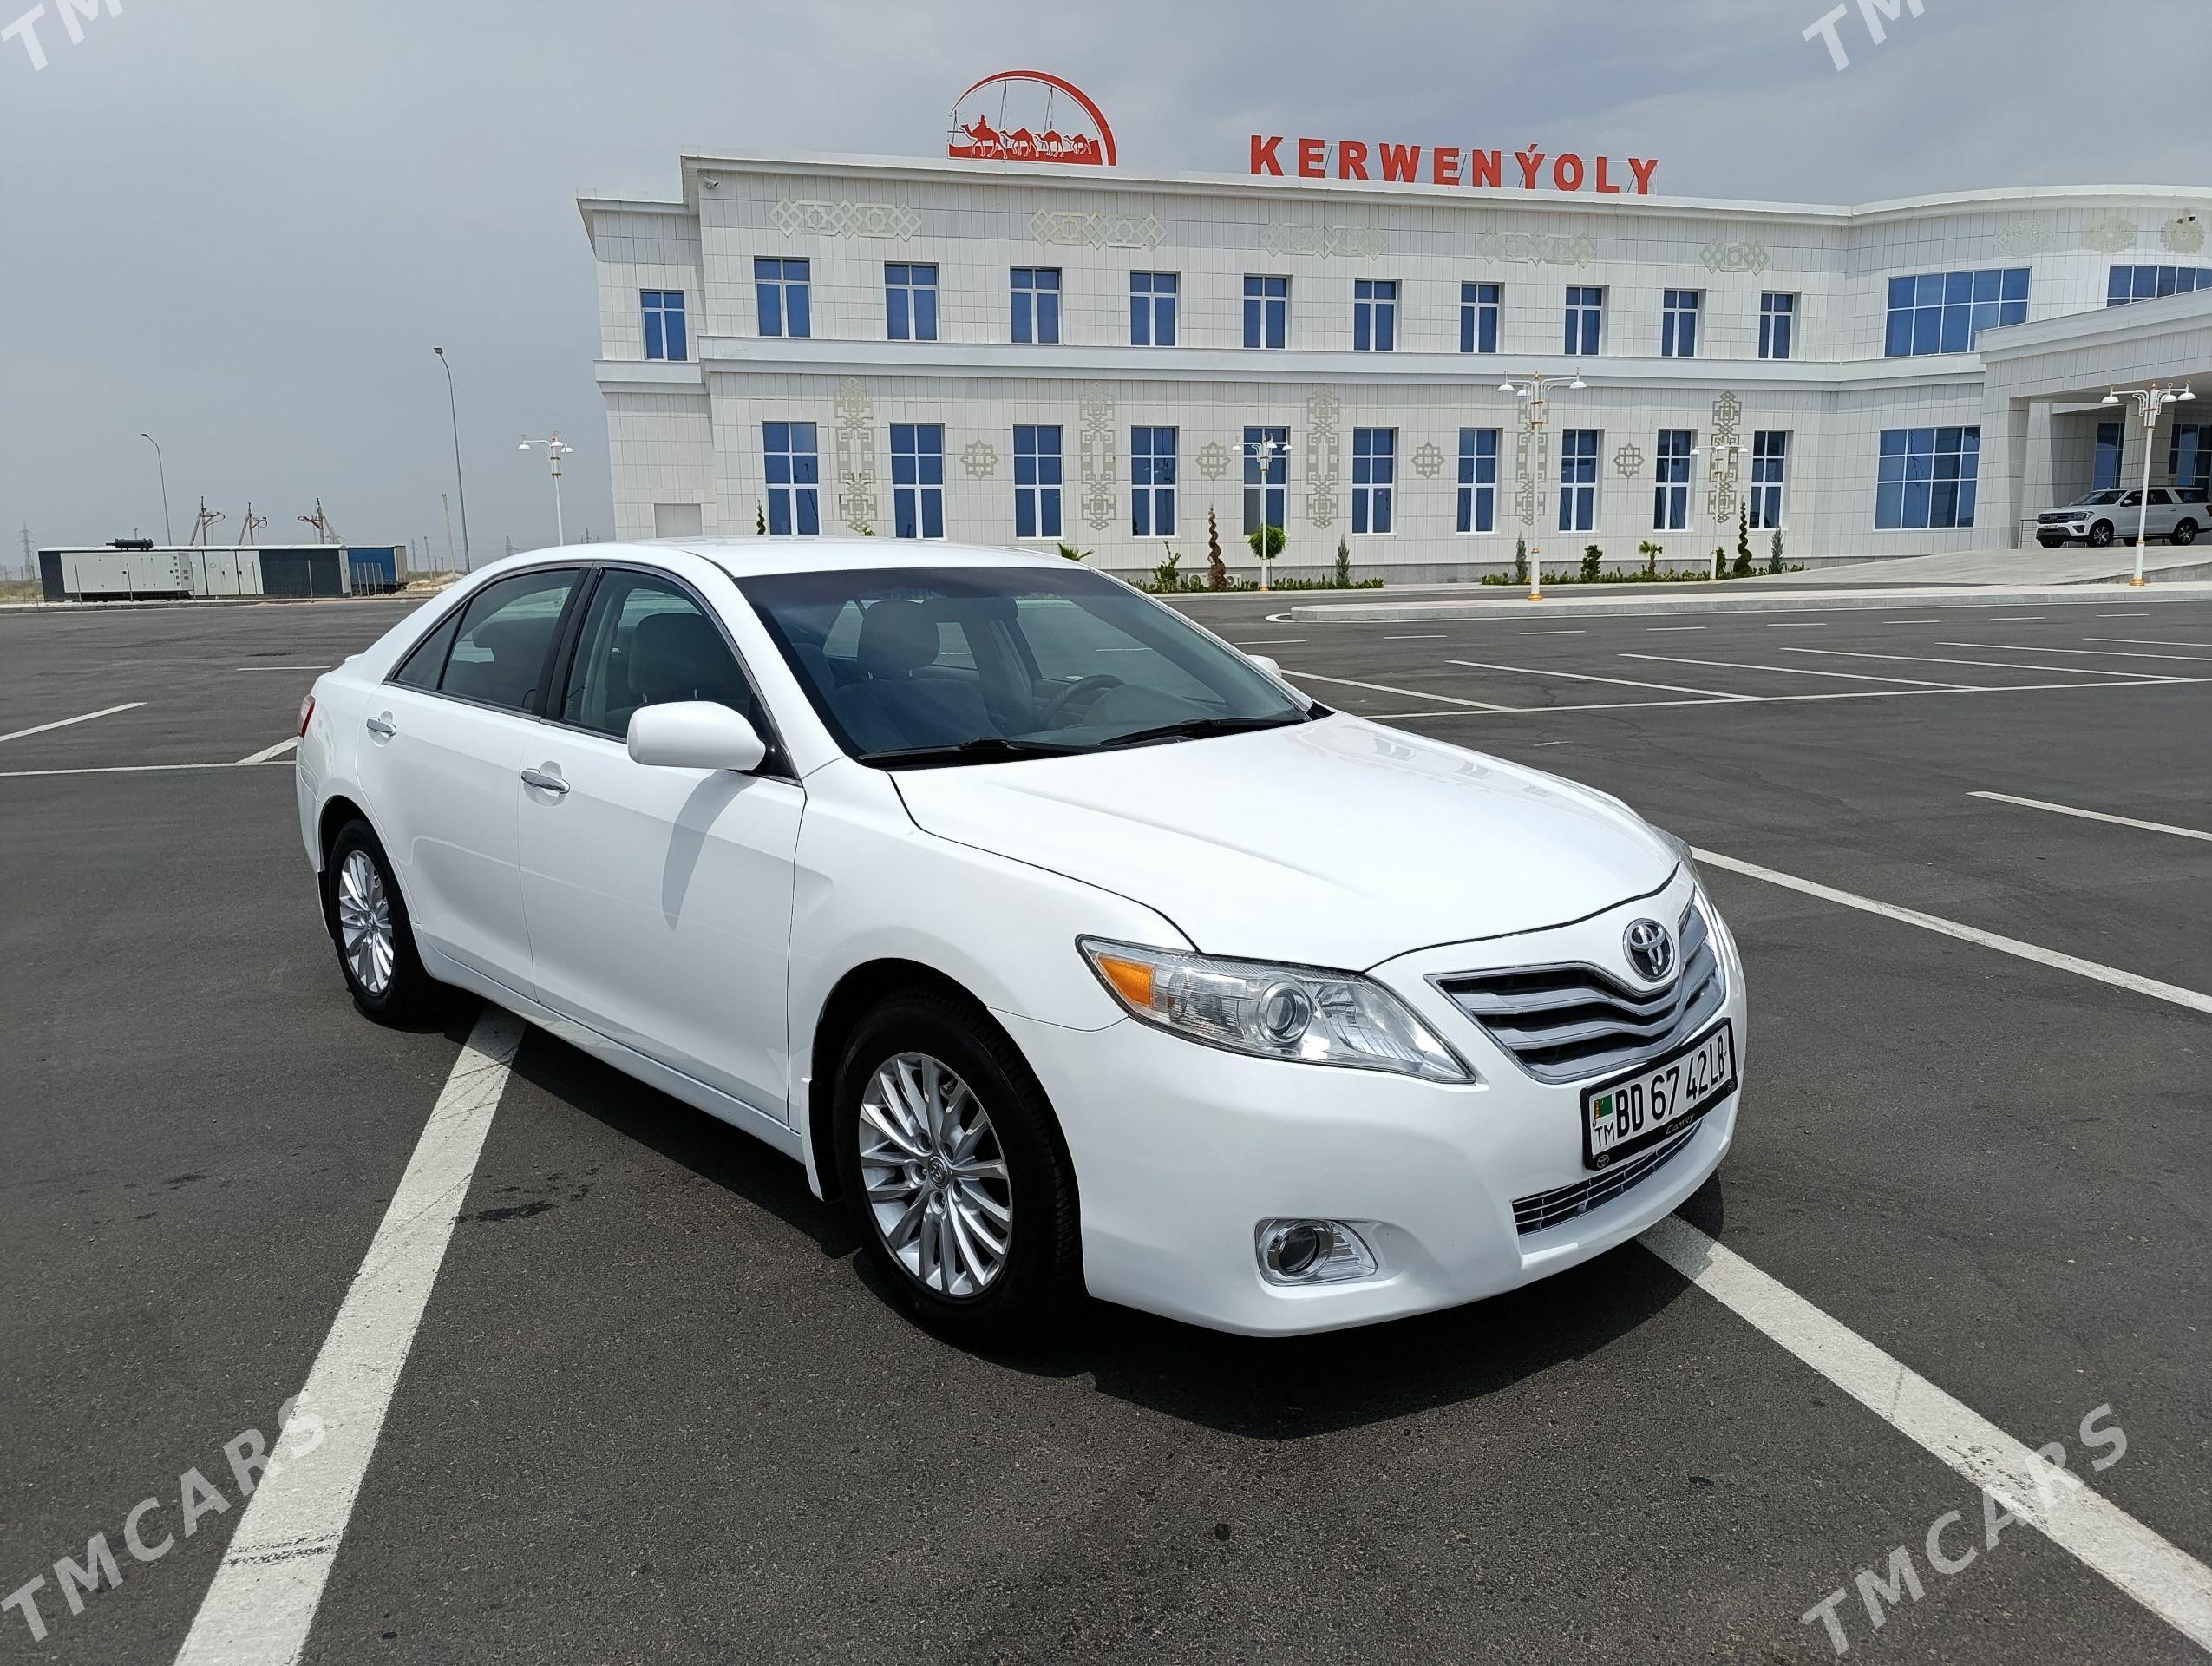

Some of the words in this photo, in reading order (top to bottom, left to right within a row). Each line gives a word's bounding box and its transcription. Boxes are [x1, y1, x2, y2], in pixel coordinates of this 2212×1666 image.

[1250, 134, 1659, 195] KERWENÝOLY
[1615, 1083, 1644, 1138] BD
[1651, 1065, 1679, 1121] 67
[1594, 1121, 1615, 1148] TM
